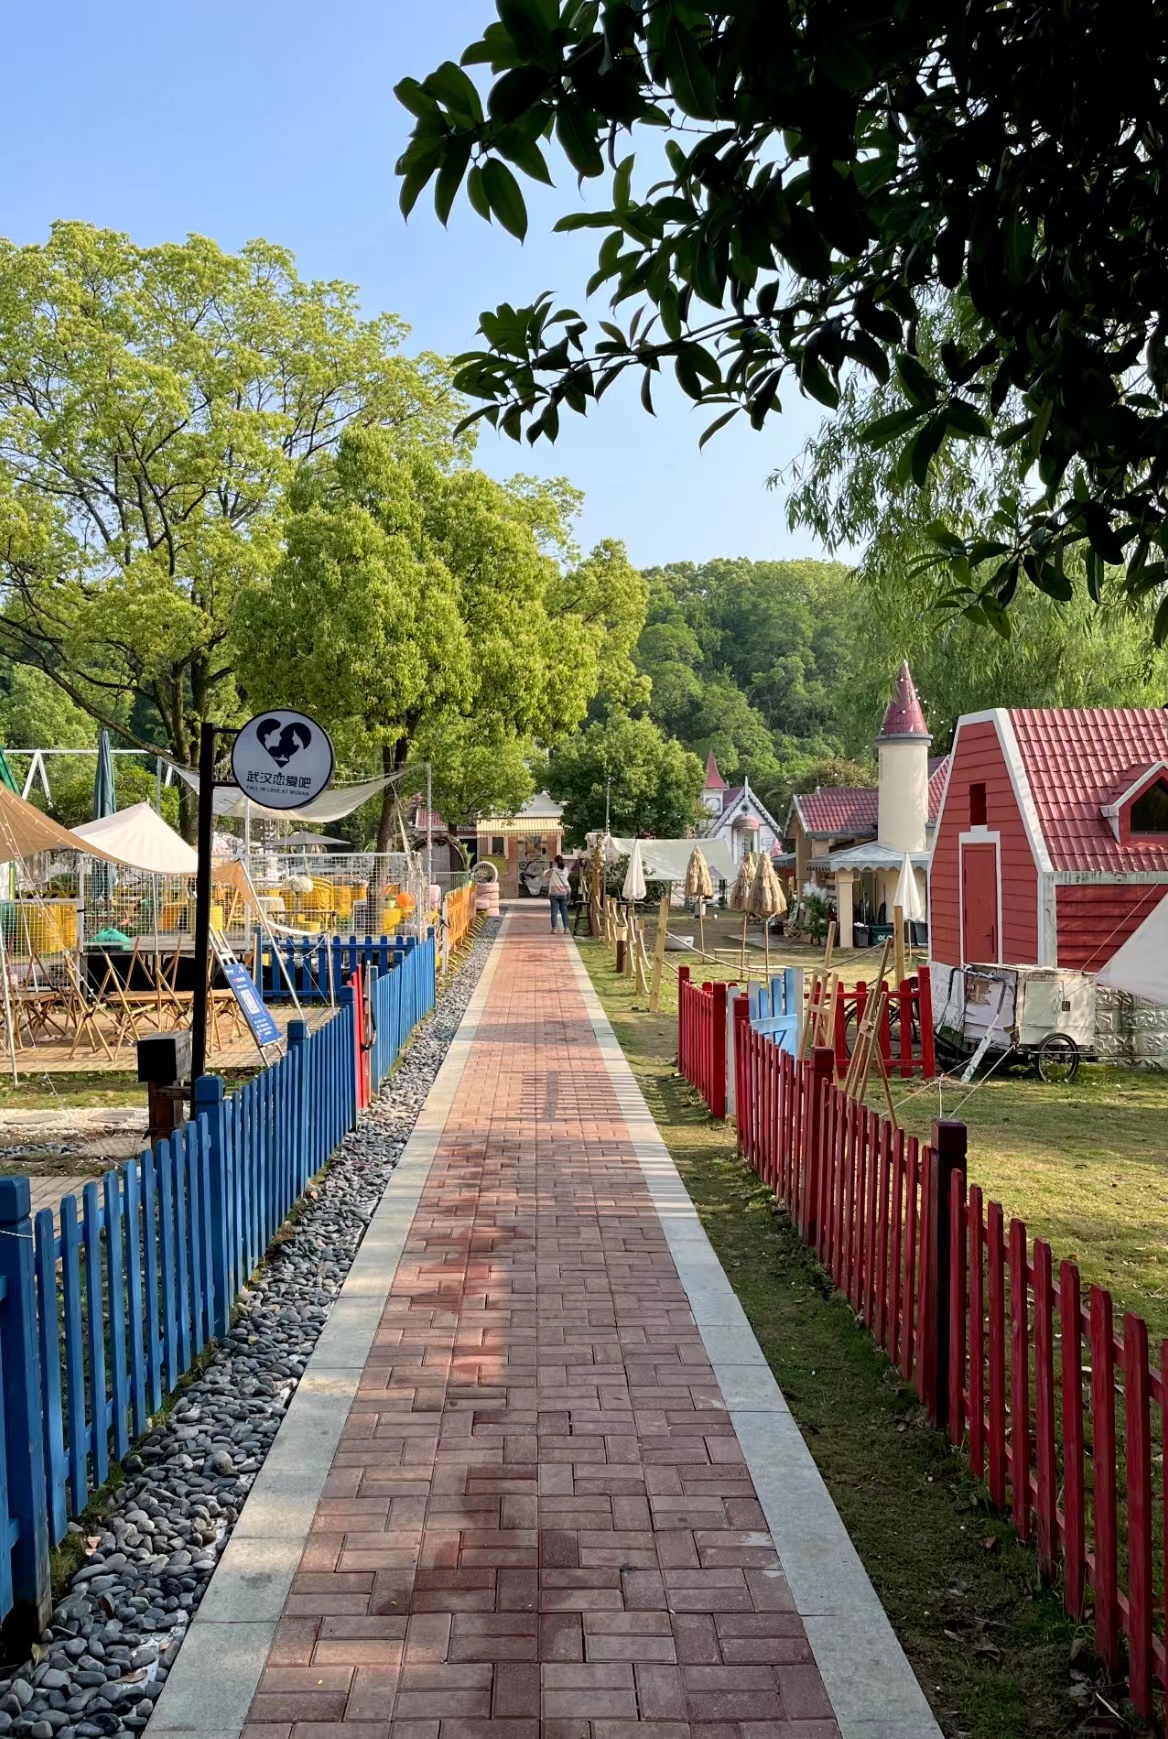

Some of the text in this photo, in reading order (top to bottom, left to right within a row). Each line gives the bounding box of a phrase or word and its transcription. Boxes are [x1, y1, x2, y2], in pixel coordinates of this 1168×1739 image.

[247, 771, 312, 788] 武汉恋爱吧
